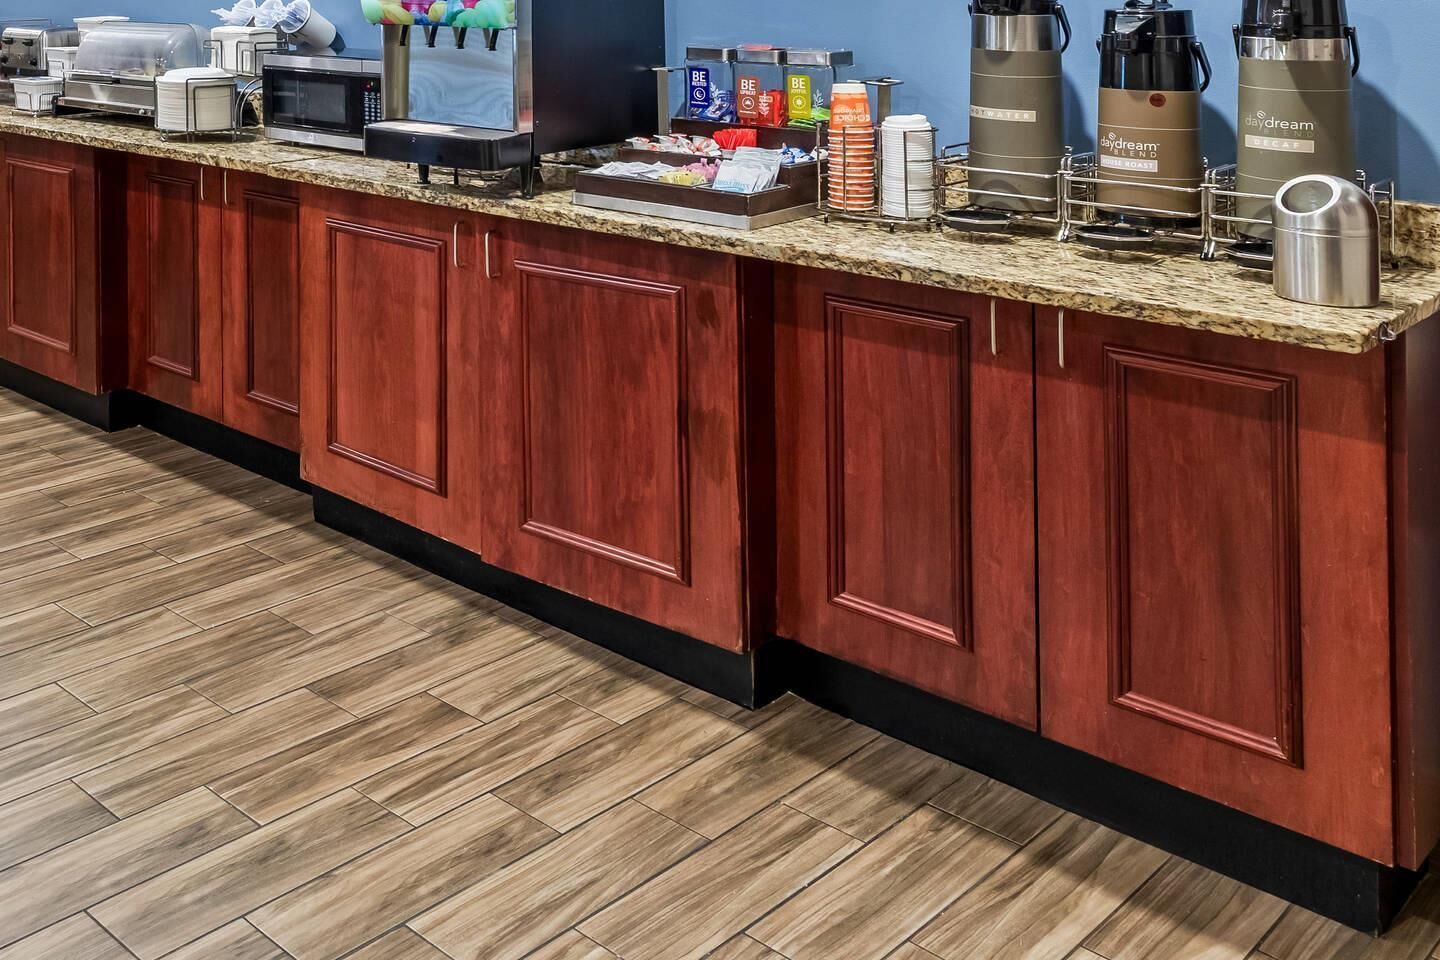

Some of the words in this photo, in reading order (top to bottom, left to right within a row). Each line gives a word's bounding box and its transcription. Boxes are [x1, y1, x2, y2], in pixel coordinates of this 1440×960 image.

[692, 71, 706, 82] BE
[741, 79, 755, 91] BE
[791, 77, 806, 89] BE
[987, 111, 1029, 120] WATER
[1244, 114, 1314, 131] daydream
[1100, 135, 1157, 152] daydream
[1254, 139, 1300, 149] DECAF
[1113, 149, 1157, 158] BLEND
[1124, 161, 1154, 169] ROAST
